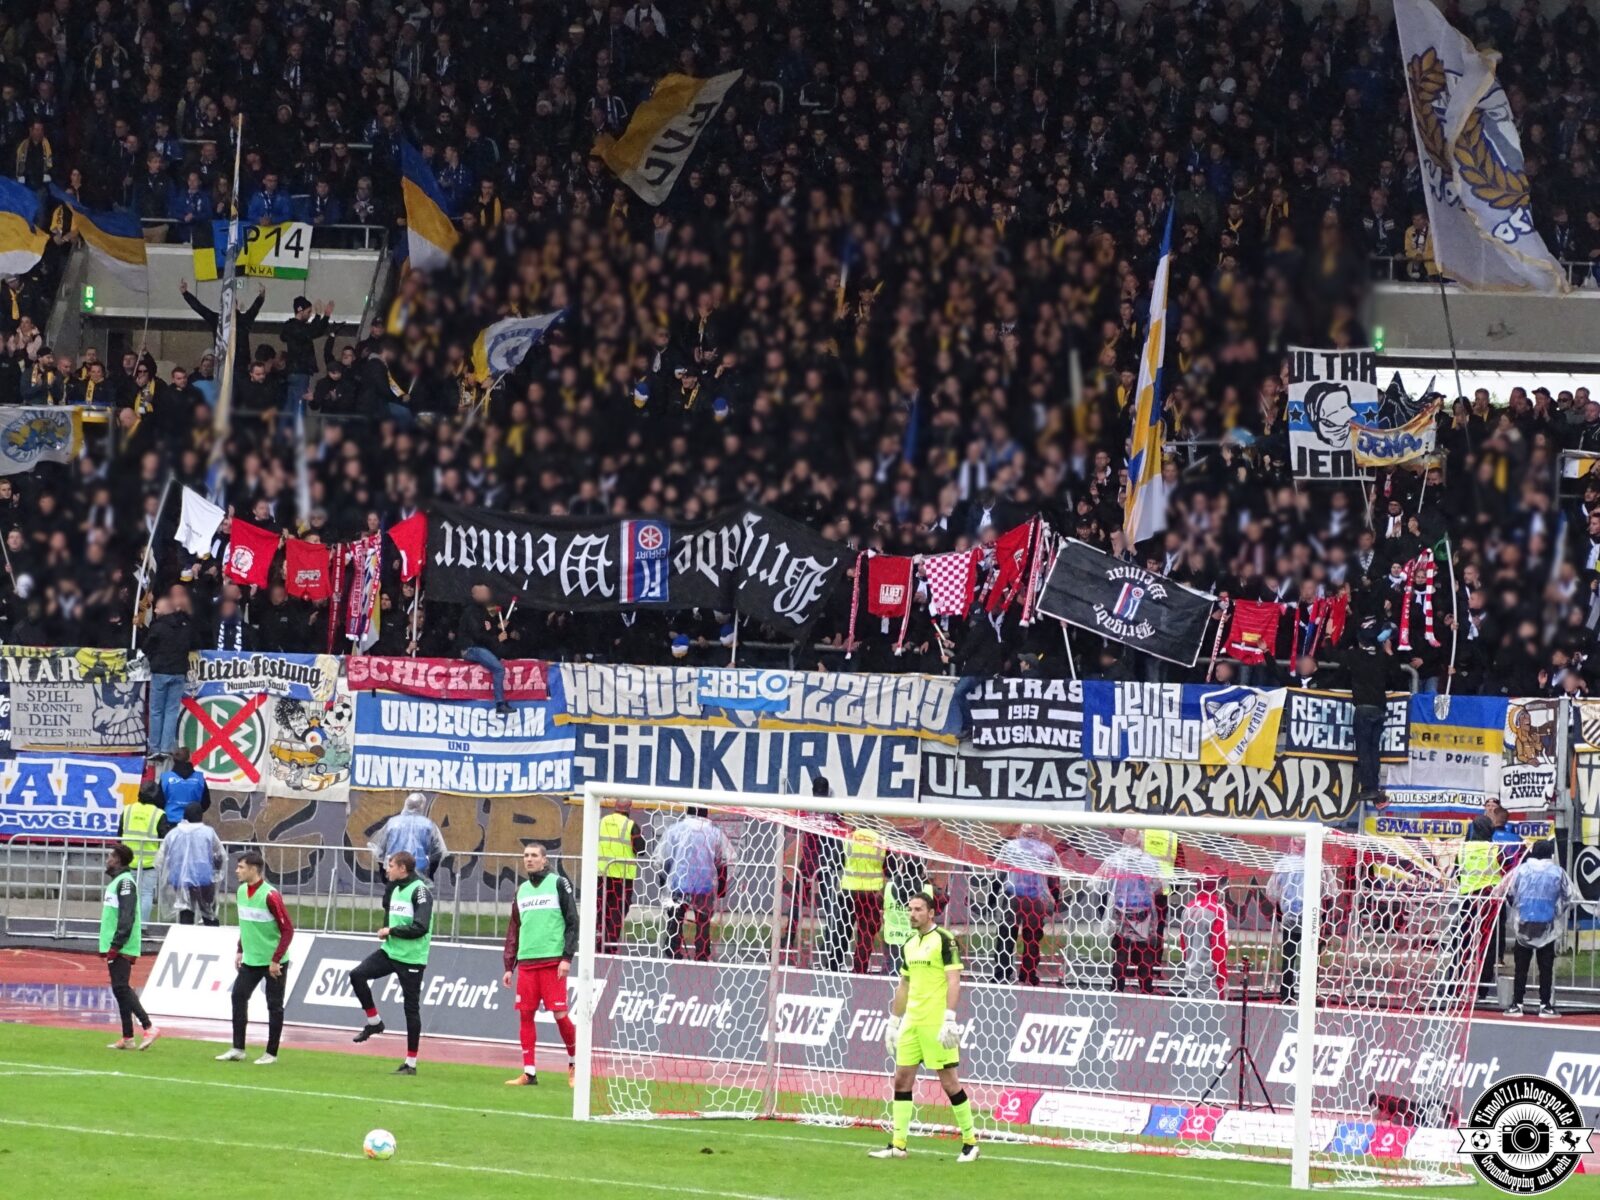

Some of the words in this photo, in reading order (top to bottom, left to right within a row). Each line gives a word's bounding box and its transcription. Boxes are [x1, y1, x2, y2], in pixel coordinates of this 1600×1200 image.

[1288, 351, 1377, 385] ULTRA
[434, 520, 615, 598] Weimar
[676, 511, 838, 624] Brigade
[1106, 566, 1168, 600] Weimar
[1092, 602, 1156, 640] Brigade
[0, 656, 84, 682] MAR
[198, 658, 248, 681] Letzte
[251, 655, 321, 690] Festung
[16, 703, 29, 712] ES
[33, 702, 83, 713] KÖNNTE
[27, 690, 74, 702] SPIEL
[1291, 696, 1407, 726] REFUES
[13, 727, 63, 737] LETZTES
[66, 728, 92, 737] SEIN
[29, 714, 72, 726] DEIN
[381, 700, 547, 738] UNBEUGSAM
[448, 741, 470, 752] UND
[973, 725, 1082, 748] LAUSANNE
[1291, 721, 1406, 752] WELCME
[355, 754, 571, 793] UNVERKÄUFLICH
[574, 724, 918, 799] SÜDKURVE
[928, 756, 1087, 800] ULTRAS
[0, 762, 117, 808] AR
[1389, 791, 1457, 804] ADOLESCENT
[1510, 786, 1545, 799] AWAY
[0, 812, 119, 831] -weiß!
[1376, 818, 1463, 836] SAALFELD
[316, 967, 352, 998] SW
[423, 976, 499, 1010] Erfurt.
[609, 991, 655, 1021] Für
[654, 995, 733, 1030] Erfurt.
[774, 1002, 832, 1037] SWE
[1020, 1022, 1083, 1056] SWE
[1097, 1029, 1146, 1061] Für
[1145, 1031, 1232, 1069] Erfurt.
[1361, 1048, 1411, 1083] Für
